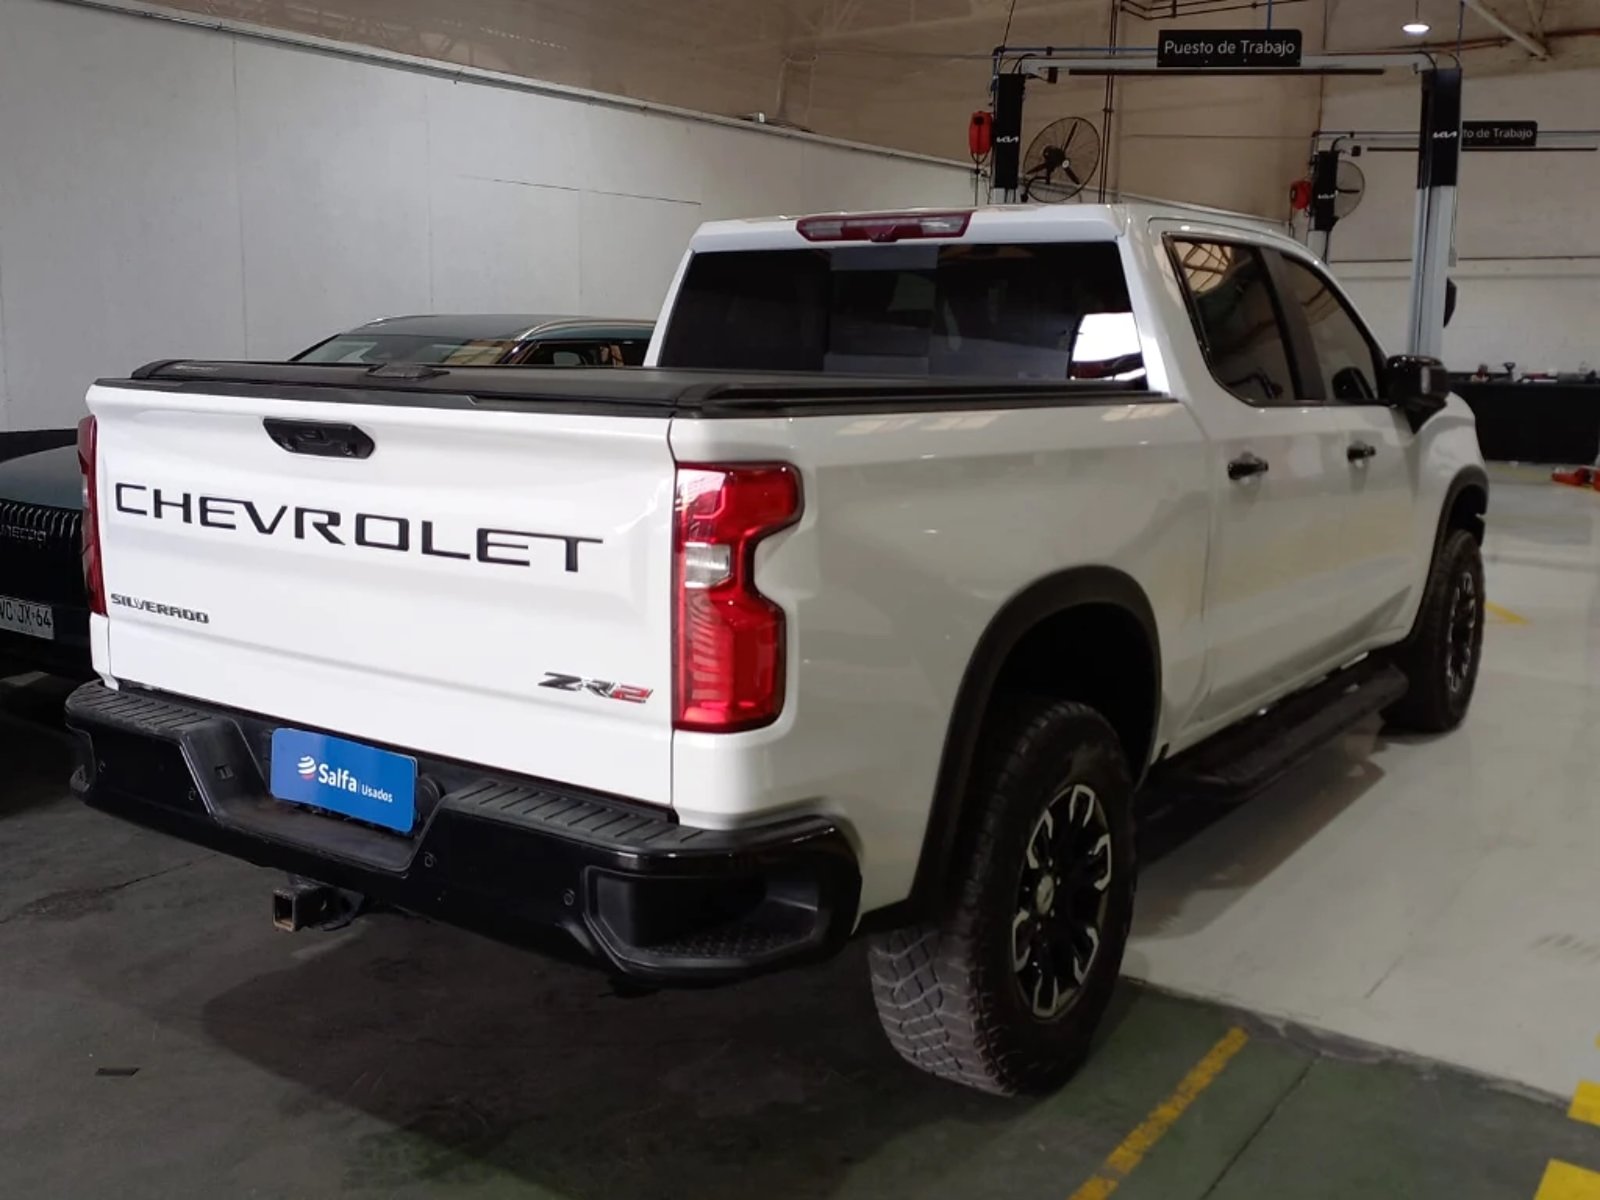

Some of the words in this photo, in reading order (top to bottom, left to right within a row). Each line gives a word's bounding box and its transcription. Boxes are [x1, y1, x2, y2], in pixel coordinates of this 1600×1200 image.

[1164, 40, 1214, 54] Puesto
[1217, 40, 1236, 54] de
[1240, 40, 1296, 57] Trabajo
[1476, 128, 1490, 139] de
[1493, 128, 1533, 140] Trabajo
[115, 482, 604, 573] CHEVROLET
[110, 593, 210, 624] SILVERADO
[537, 671, 654, 704] ZR2
[318, 763, 357, 792] Salfa
[361, 784, 393, 803] Usados
